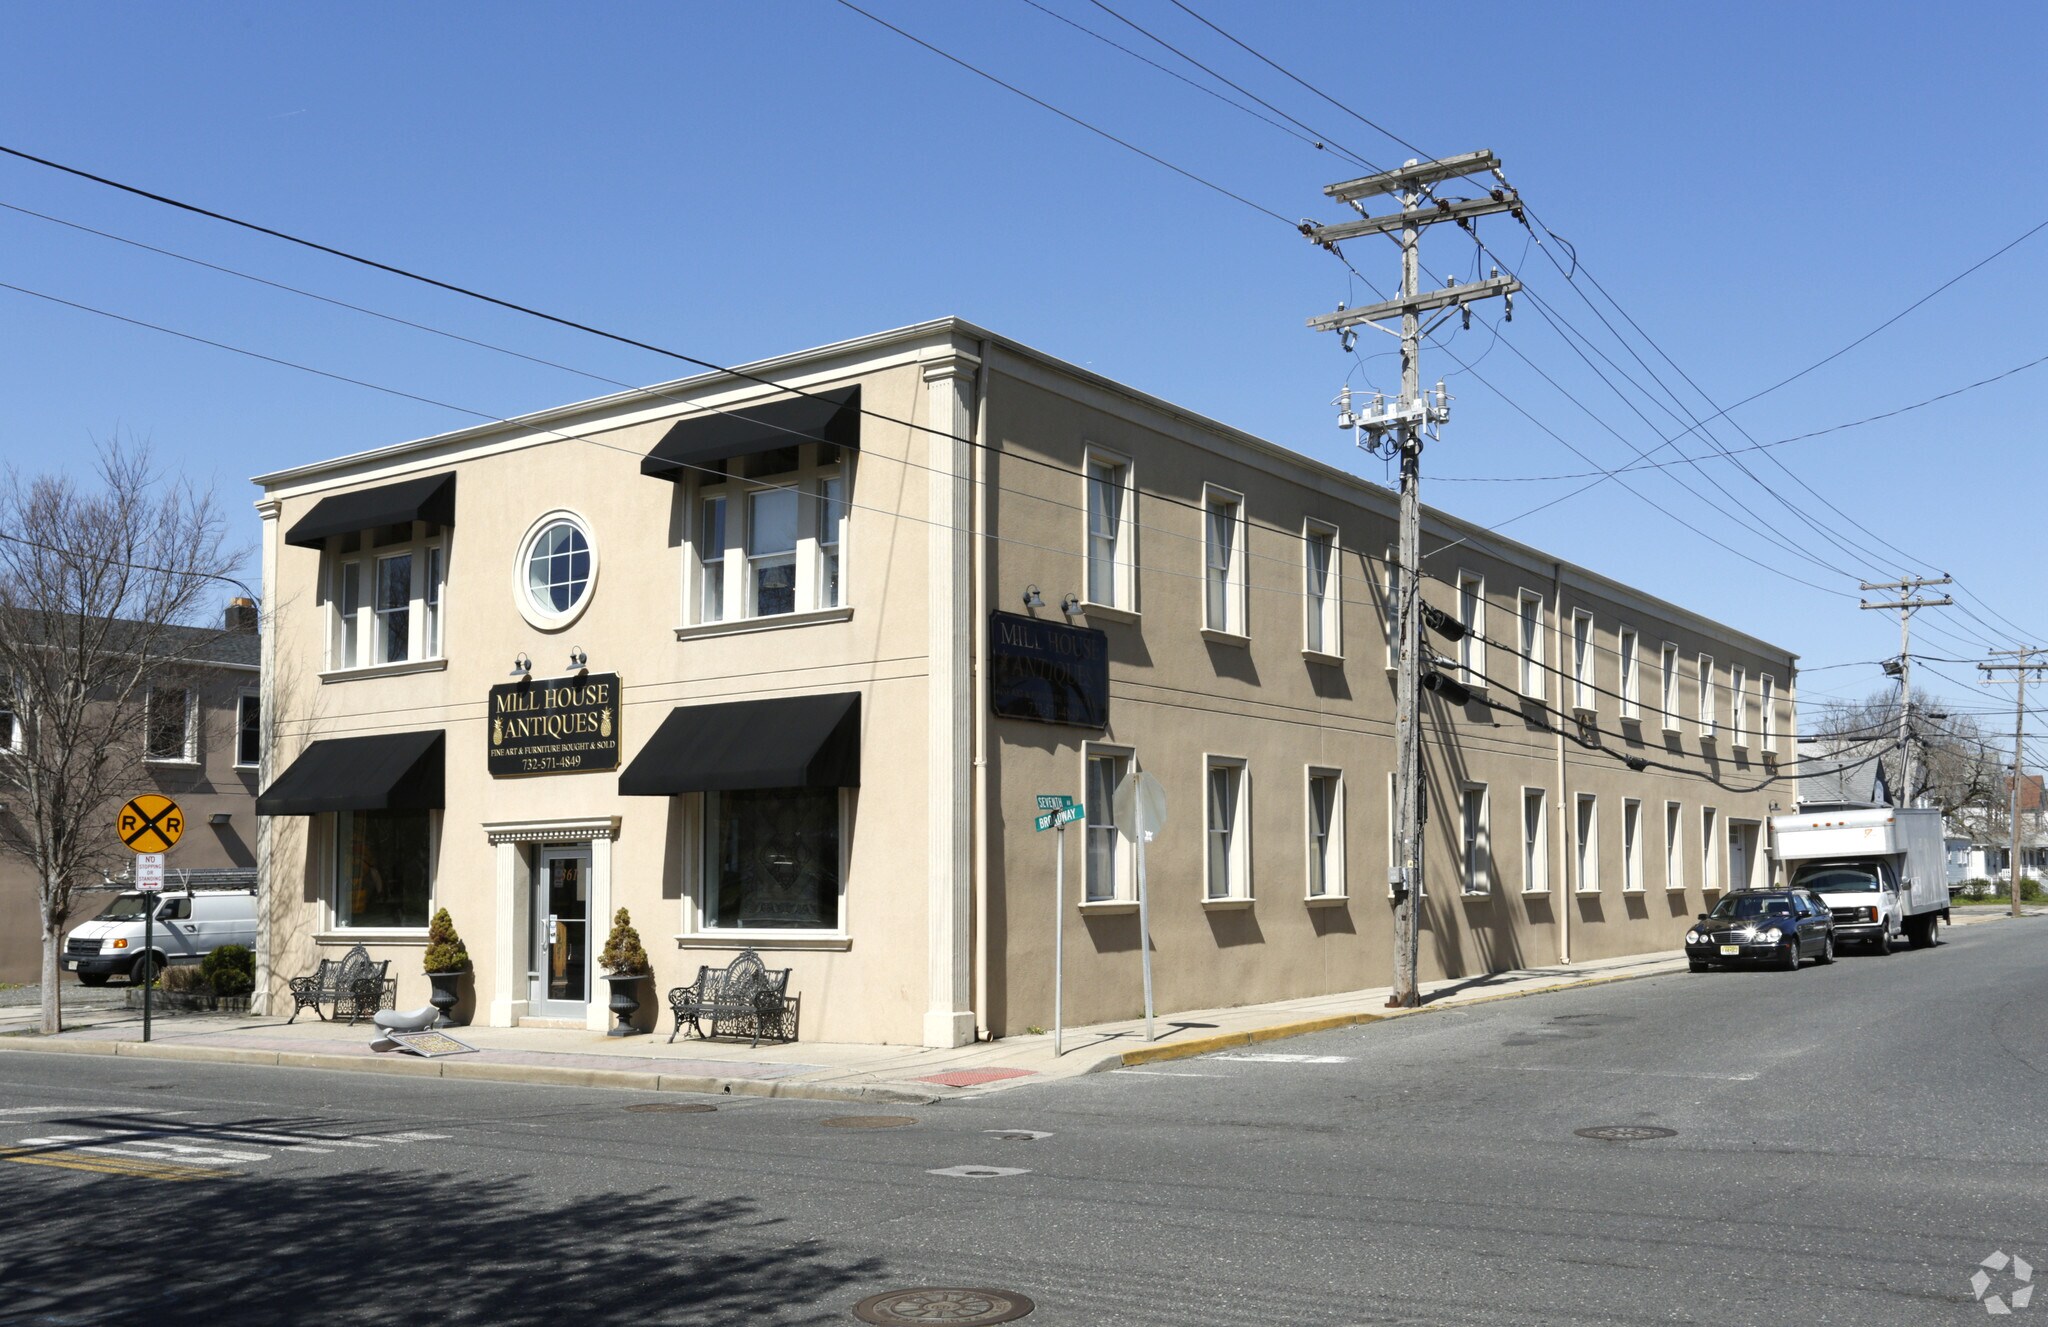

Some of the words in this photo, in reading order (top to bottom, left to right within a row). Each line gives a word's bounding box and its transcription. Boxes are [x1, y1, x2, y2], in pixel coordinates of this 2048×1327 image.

[1001, 622, 1042, 650] MILL
[1047, 631, 1100, 660] HOUSE
[496, 691, 540, 713] MILL
[544, 684, 609, 709] HOUSE
[504, 712, 598, 739] ANTIQUES
[490, 748, 504, 757] FINE
[505, 747, 518, 756] ART
[518, 747, 524, 755] &
[524, 744, 561, 755] FURNITURE
[561, 742, 590, 752] BOUGHT
[589, 741, 596, 750] &
[597, 740, 616, 749] SOLD
[522, 754, 581, 771] 732-571-4849
[1038, 797, 1063, 808] SEVENTH
[122, 816, 136, 830] R
[167, 818, 180, 832] R
